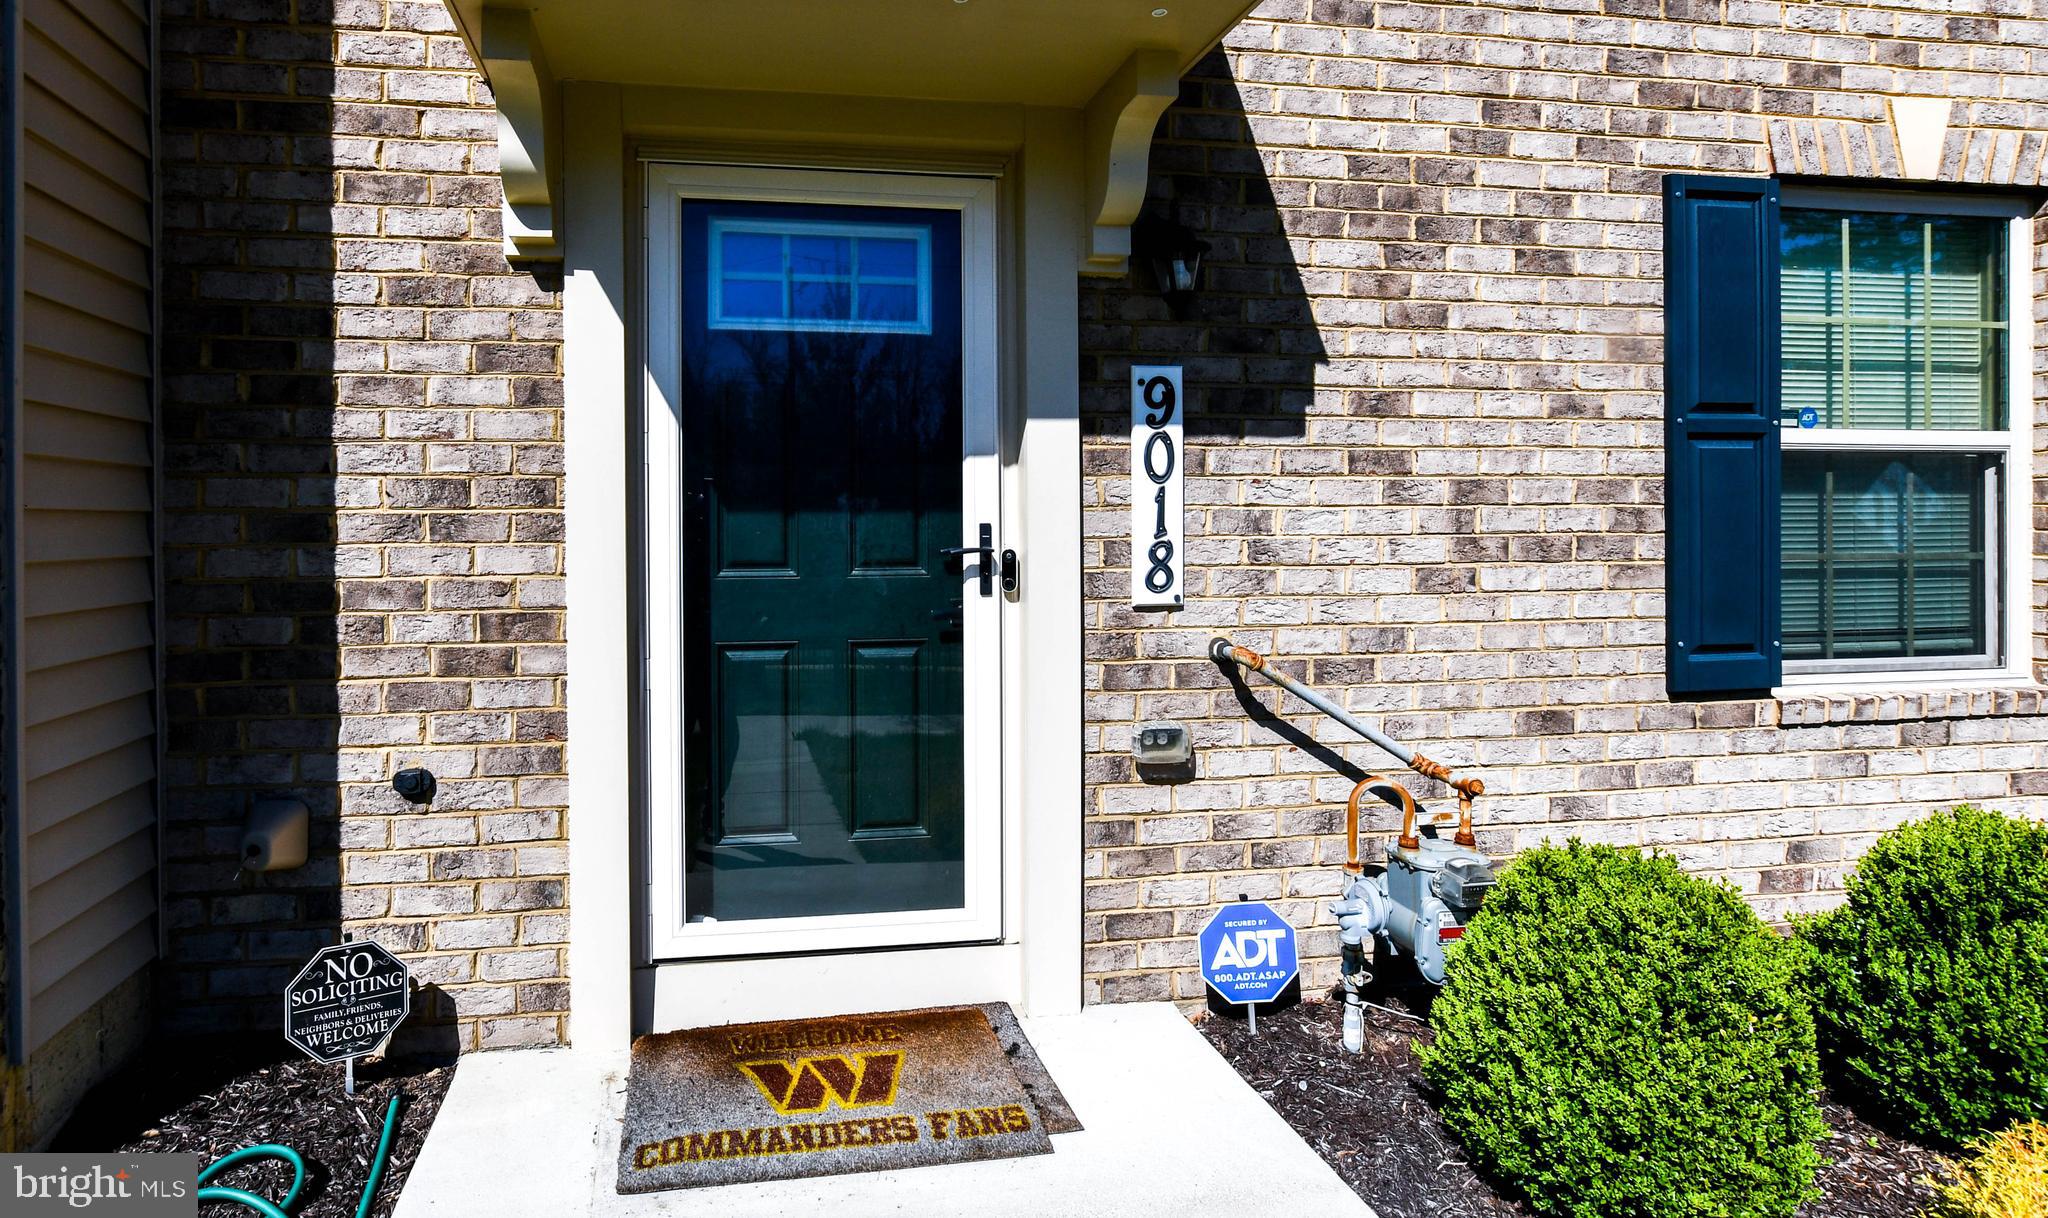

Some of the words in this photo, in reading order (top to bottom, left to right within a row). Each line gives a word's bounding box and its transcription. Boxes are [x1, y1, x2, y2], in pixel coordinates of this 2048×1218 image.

[1802, 413, 1815, 421] ADT
[1143, 376, 1176, 594] 9018
[1211, 930, 1287, 970] ADT
[324, 952, 373, 985] NO
[1214, 971, 1287, 982] 800.ADT.ASAP
[291, 971, 403, 1007] SOLICITING
[1234, 981, 1268, 990] ADT.COM
[294, 1020, 345, 1037] NEIGHBORS
[345, 1017, 353, 1025] &
[355, 1008, 402, 1024] DELIVERIES
[306, 1018, 389, 1048] WELCOME
[728, 1022, 902, 1055] WELCOME
[633, 1116, 919, 1170] COMMANDERS
[925, 1103, 1034, 1140] FANS
